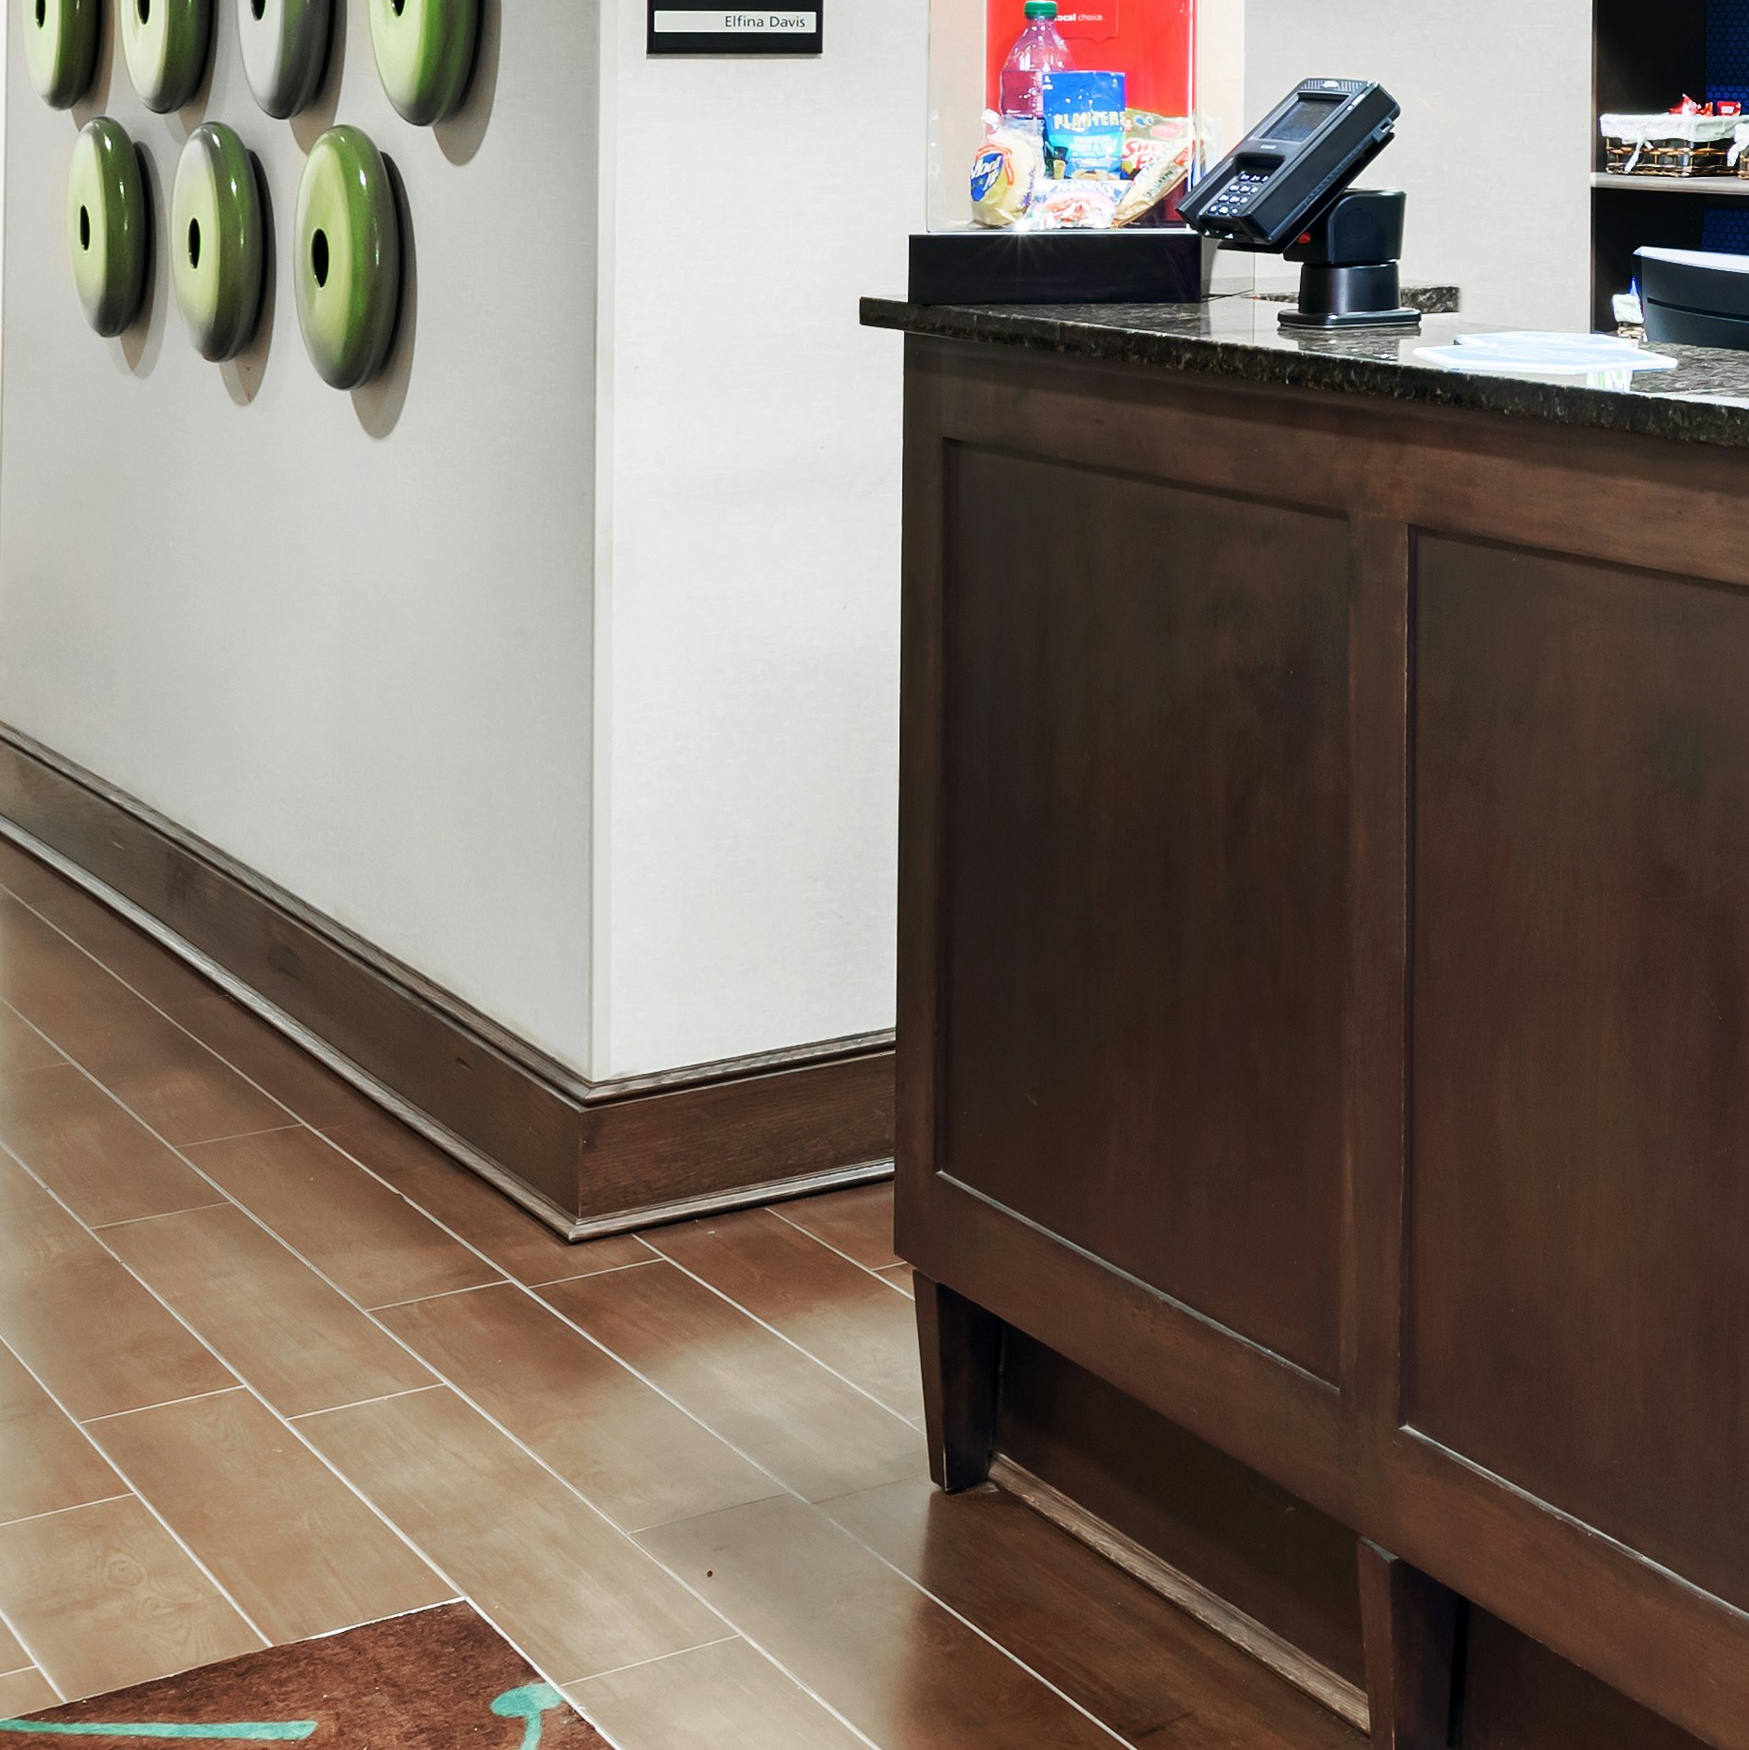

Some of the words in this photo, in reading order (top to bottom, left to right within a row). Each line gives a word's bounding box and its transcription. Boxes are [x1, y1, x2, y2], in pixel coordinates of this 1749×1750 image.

[724, 14, 764, 28] Elfina
[769, 15, 806, 28] Davis
[1055, 13, 1077, 22] ocal
[1078, 13, 1103, 22] choice
